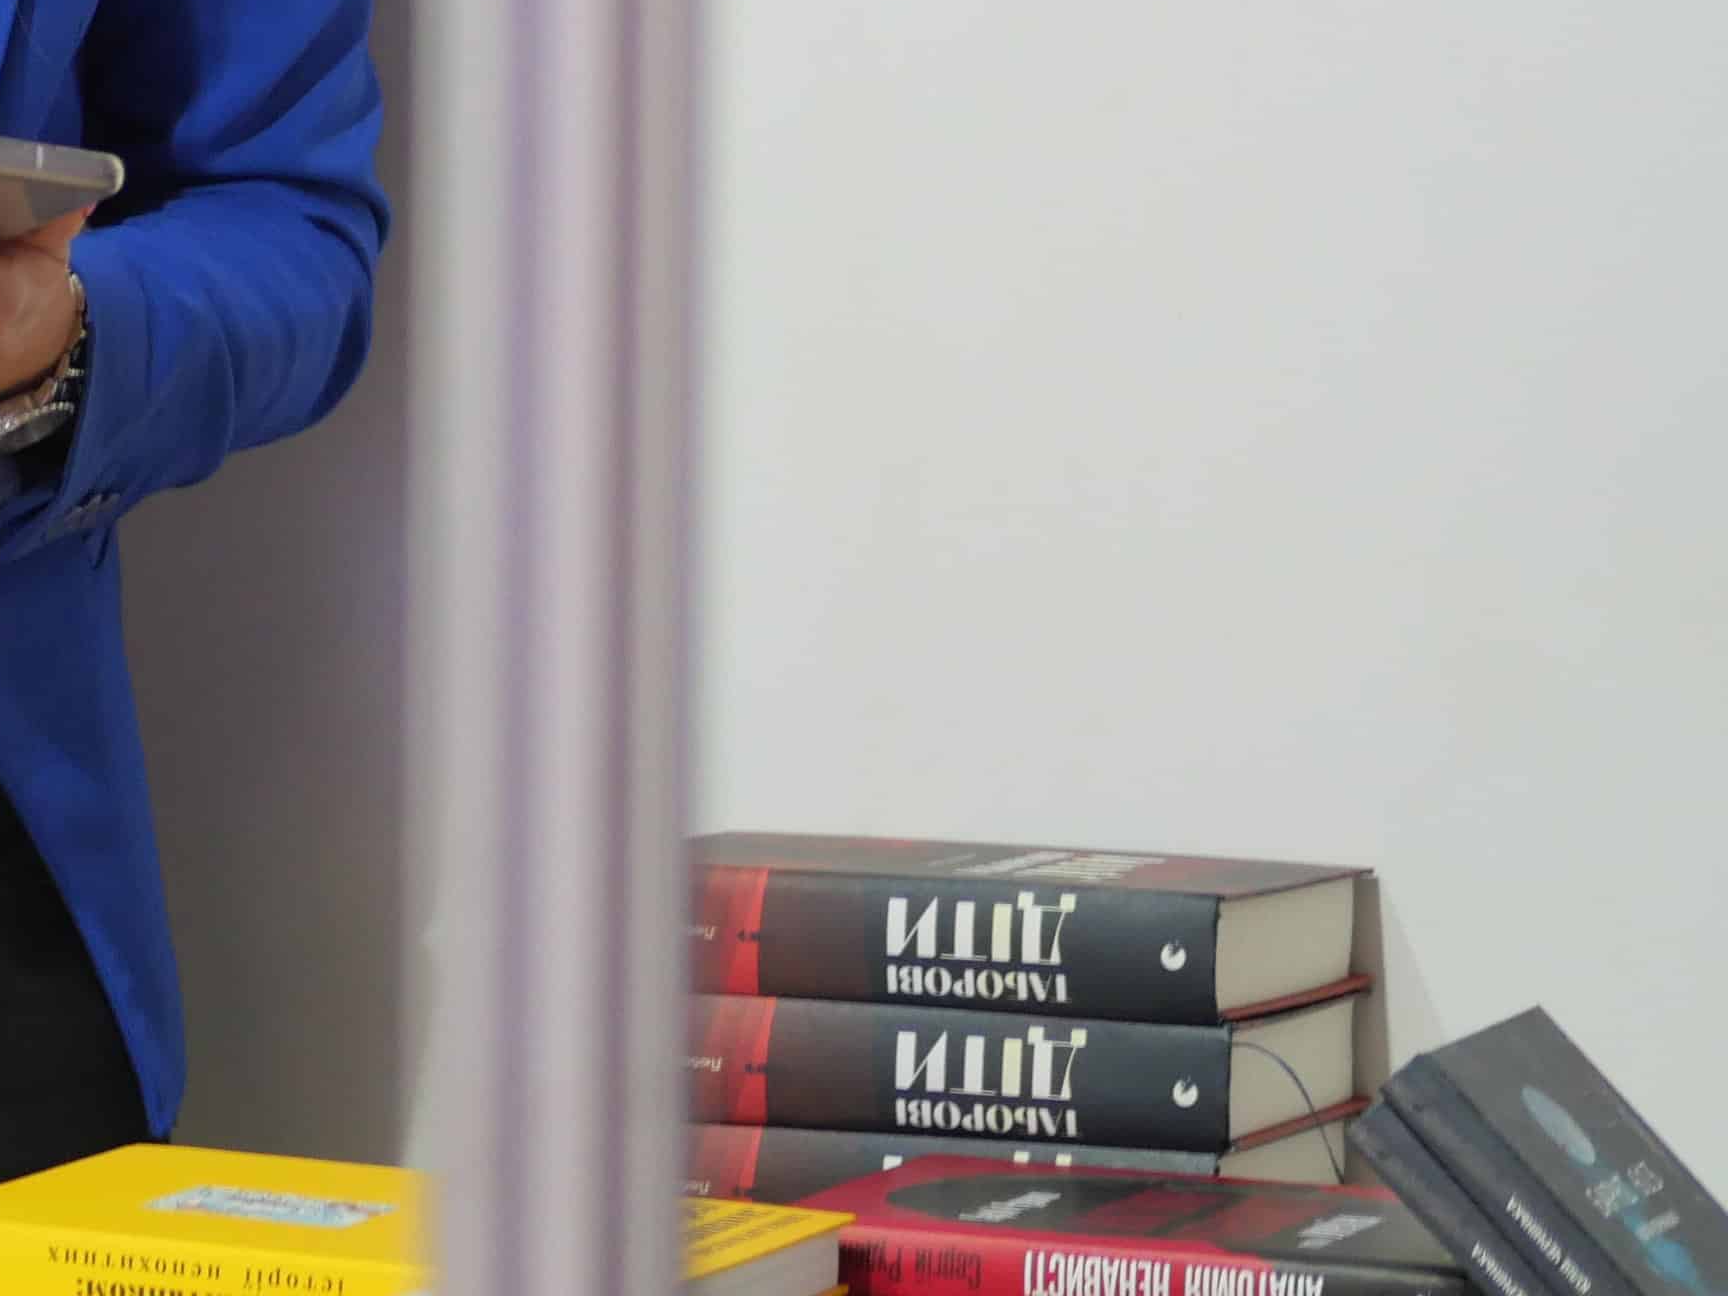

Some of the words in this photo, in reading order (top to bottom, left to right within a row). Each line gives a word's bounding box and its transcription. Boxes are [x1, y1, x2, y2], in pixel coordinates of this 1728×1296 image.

[886, 890, 1078, 965] ДІТИ
[886, 964, 1073, 1003] ТАБОРОВІ
[895, 1025, 1088, 1101] ДІТИ
[895, 1098, 1081, 1137] ТАБОРОВІ
[1022, 1249, 1171, 1296] НЕНАВИСТІ
